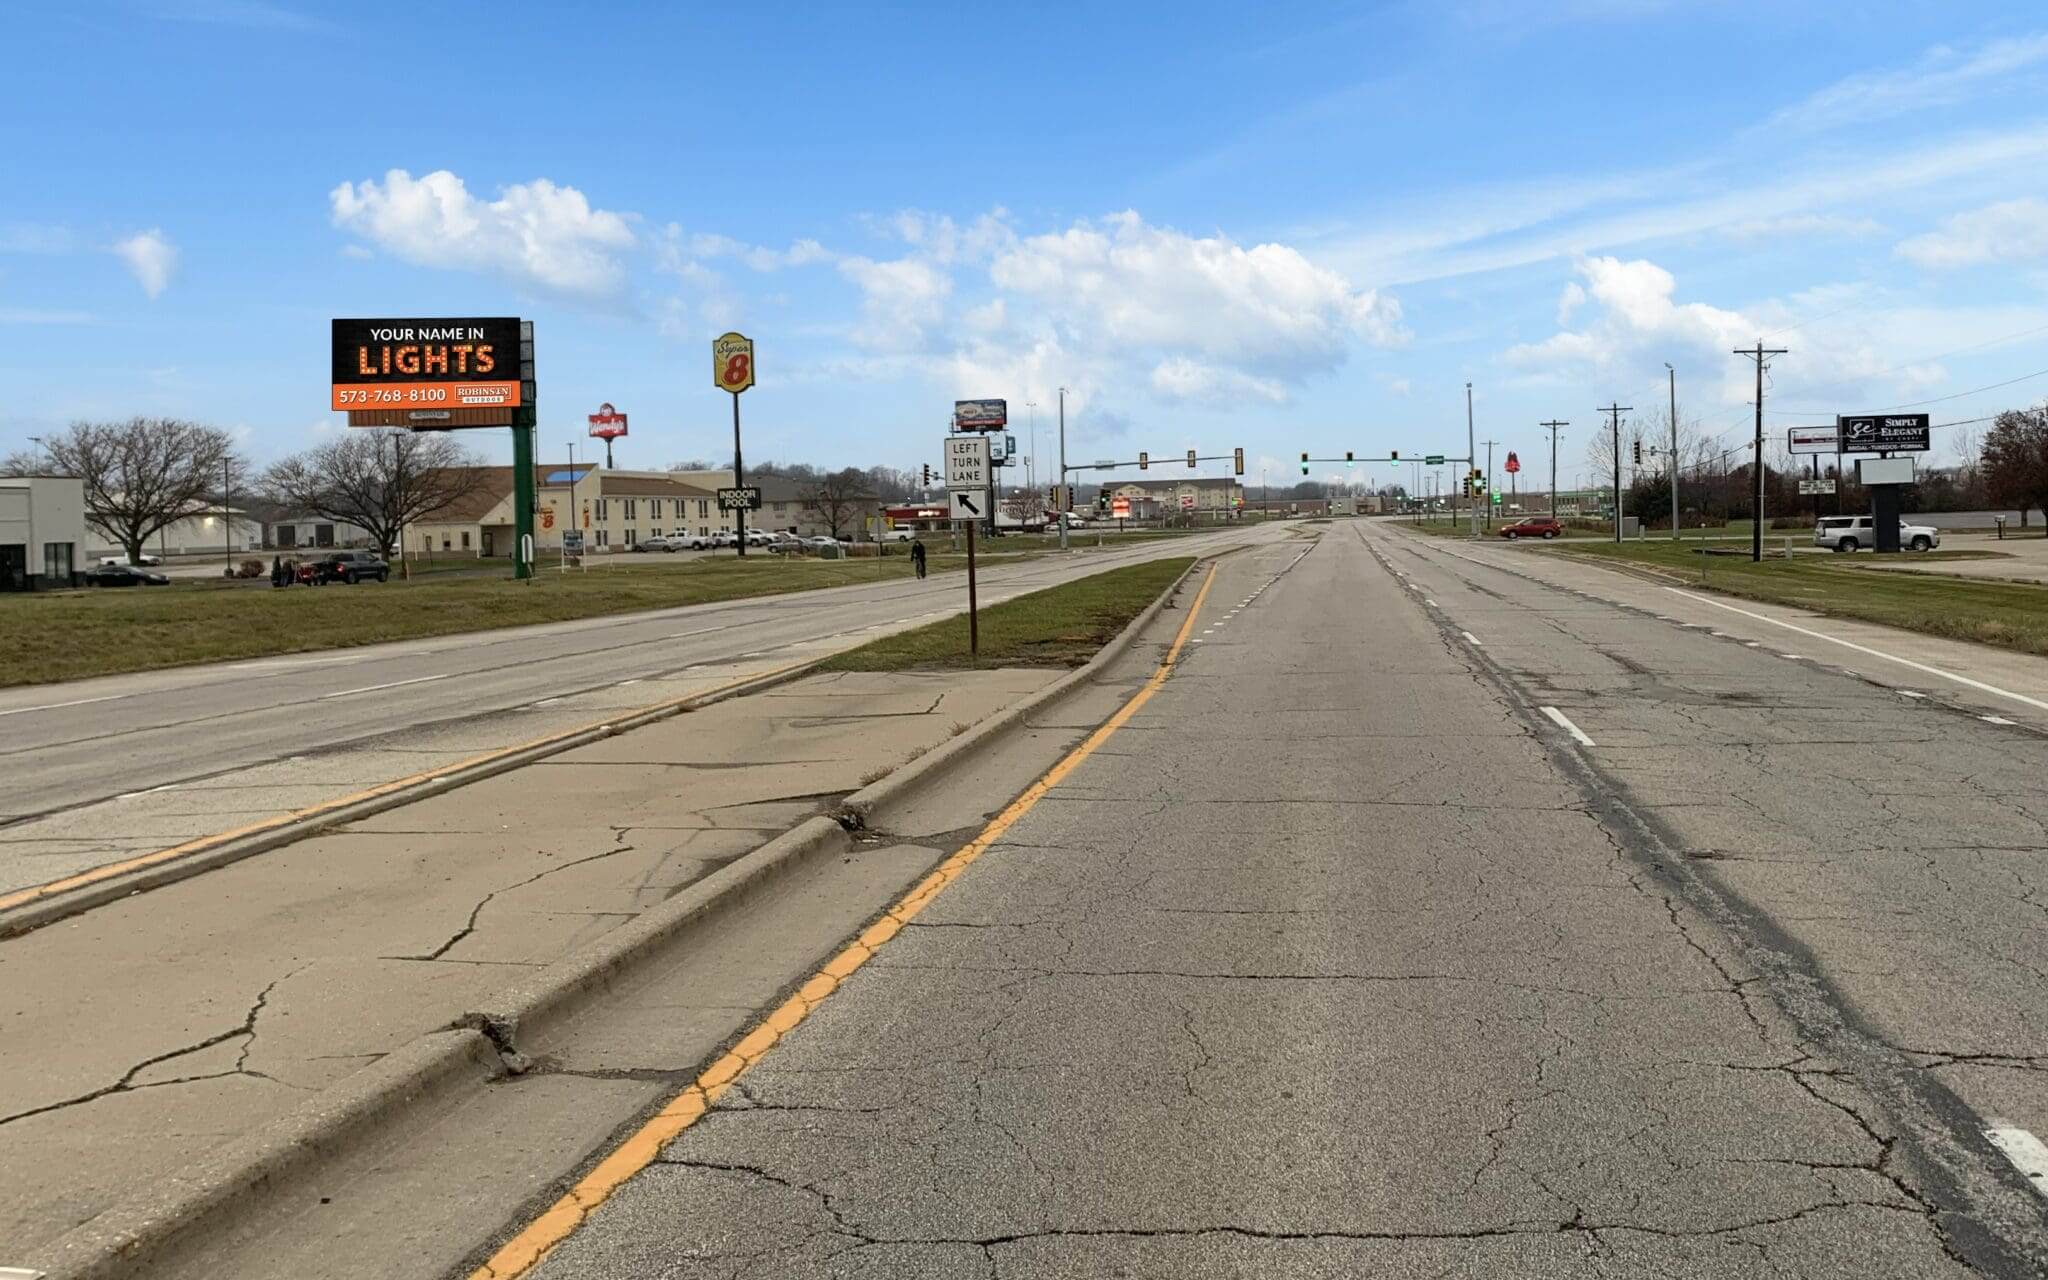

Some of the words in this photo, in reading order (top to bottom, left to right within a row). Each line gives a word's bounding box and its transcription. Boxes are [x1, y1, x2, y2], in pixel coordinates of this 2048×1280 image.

[370, 328, 415, 341] YOUR
[418, 328, 465, 340] NAME
[468, 327, 484, 340] IN
[717, 340, 750, 358] Super
[359, 344, 495, 375] LIGHTS
[723, 353, 749, 385] 8
[339, 388, 446, 403] 573-768-8100
[590, 417, 624, 434] Wendy's
[1885, 418, 1918, 427] SIMPLY
[1881, 427, 1924, 436] ELEGANT
[953, 443, 978, 454] LEFT
[953, 457, 980, 467] TURN
[953, 471, 980, 481] LANE
[719, 489, 756, 499] INDOOR
[725, 498, 751, 508] POOL
